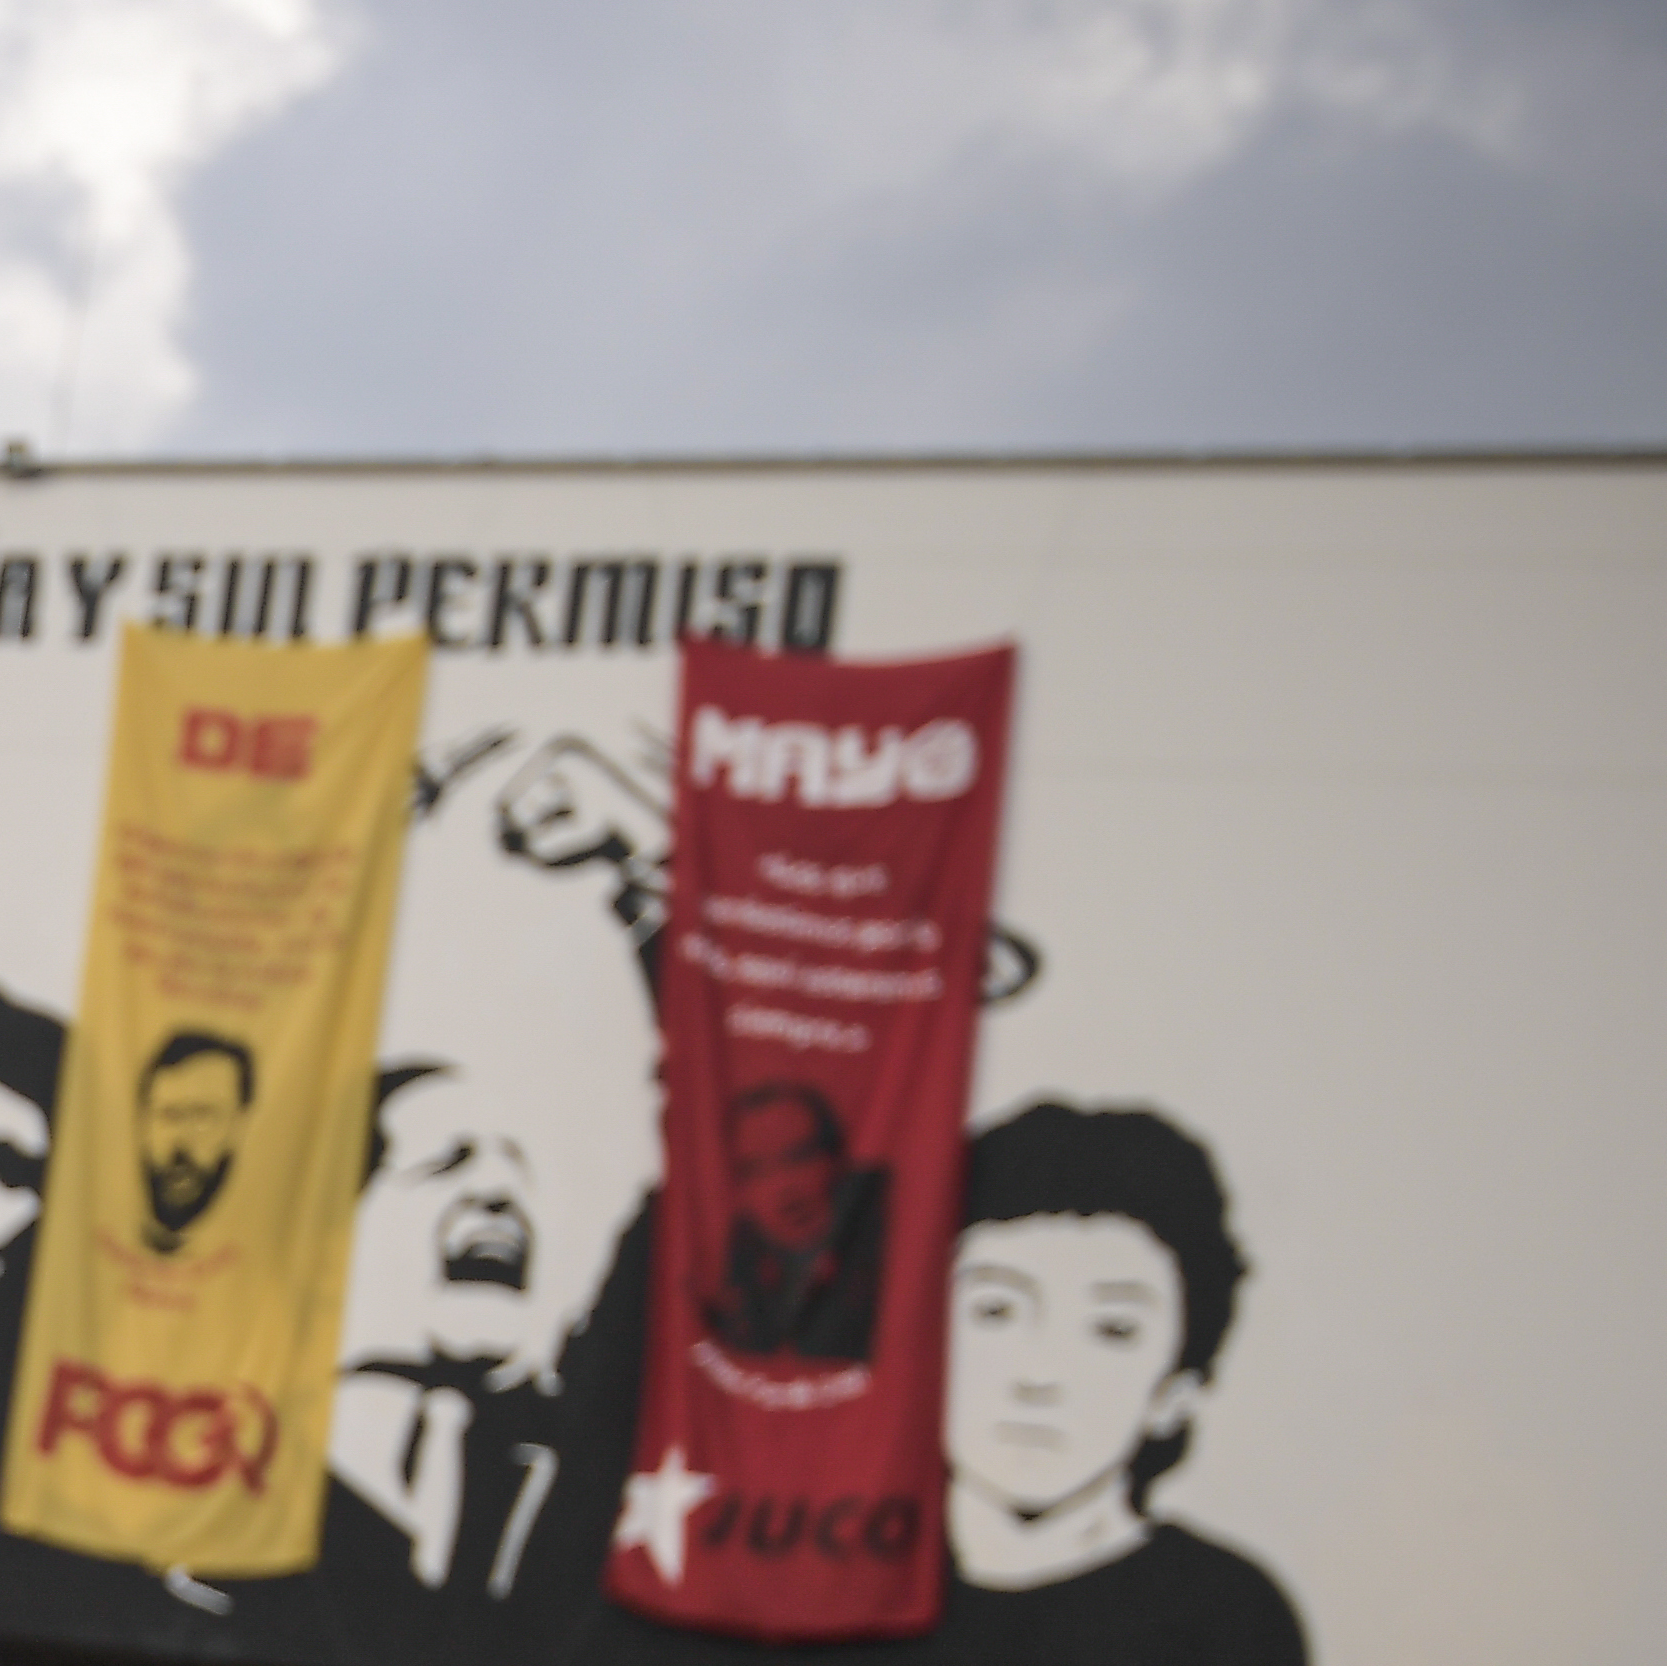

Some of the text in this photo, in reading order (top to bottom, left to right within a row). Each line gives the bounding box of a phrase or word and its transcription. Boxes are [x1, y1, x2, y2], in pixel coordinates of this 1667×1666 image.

[70, 553, 127, 640] Y
[151, 556, 315, 640] SIN
[352, 557, 847, 655] PERMISO
